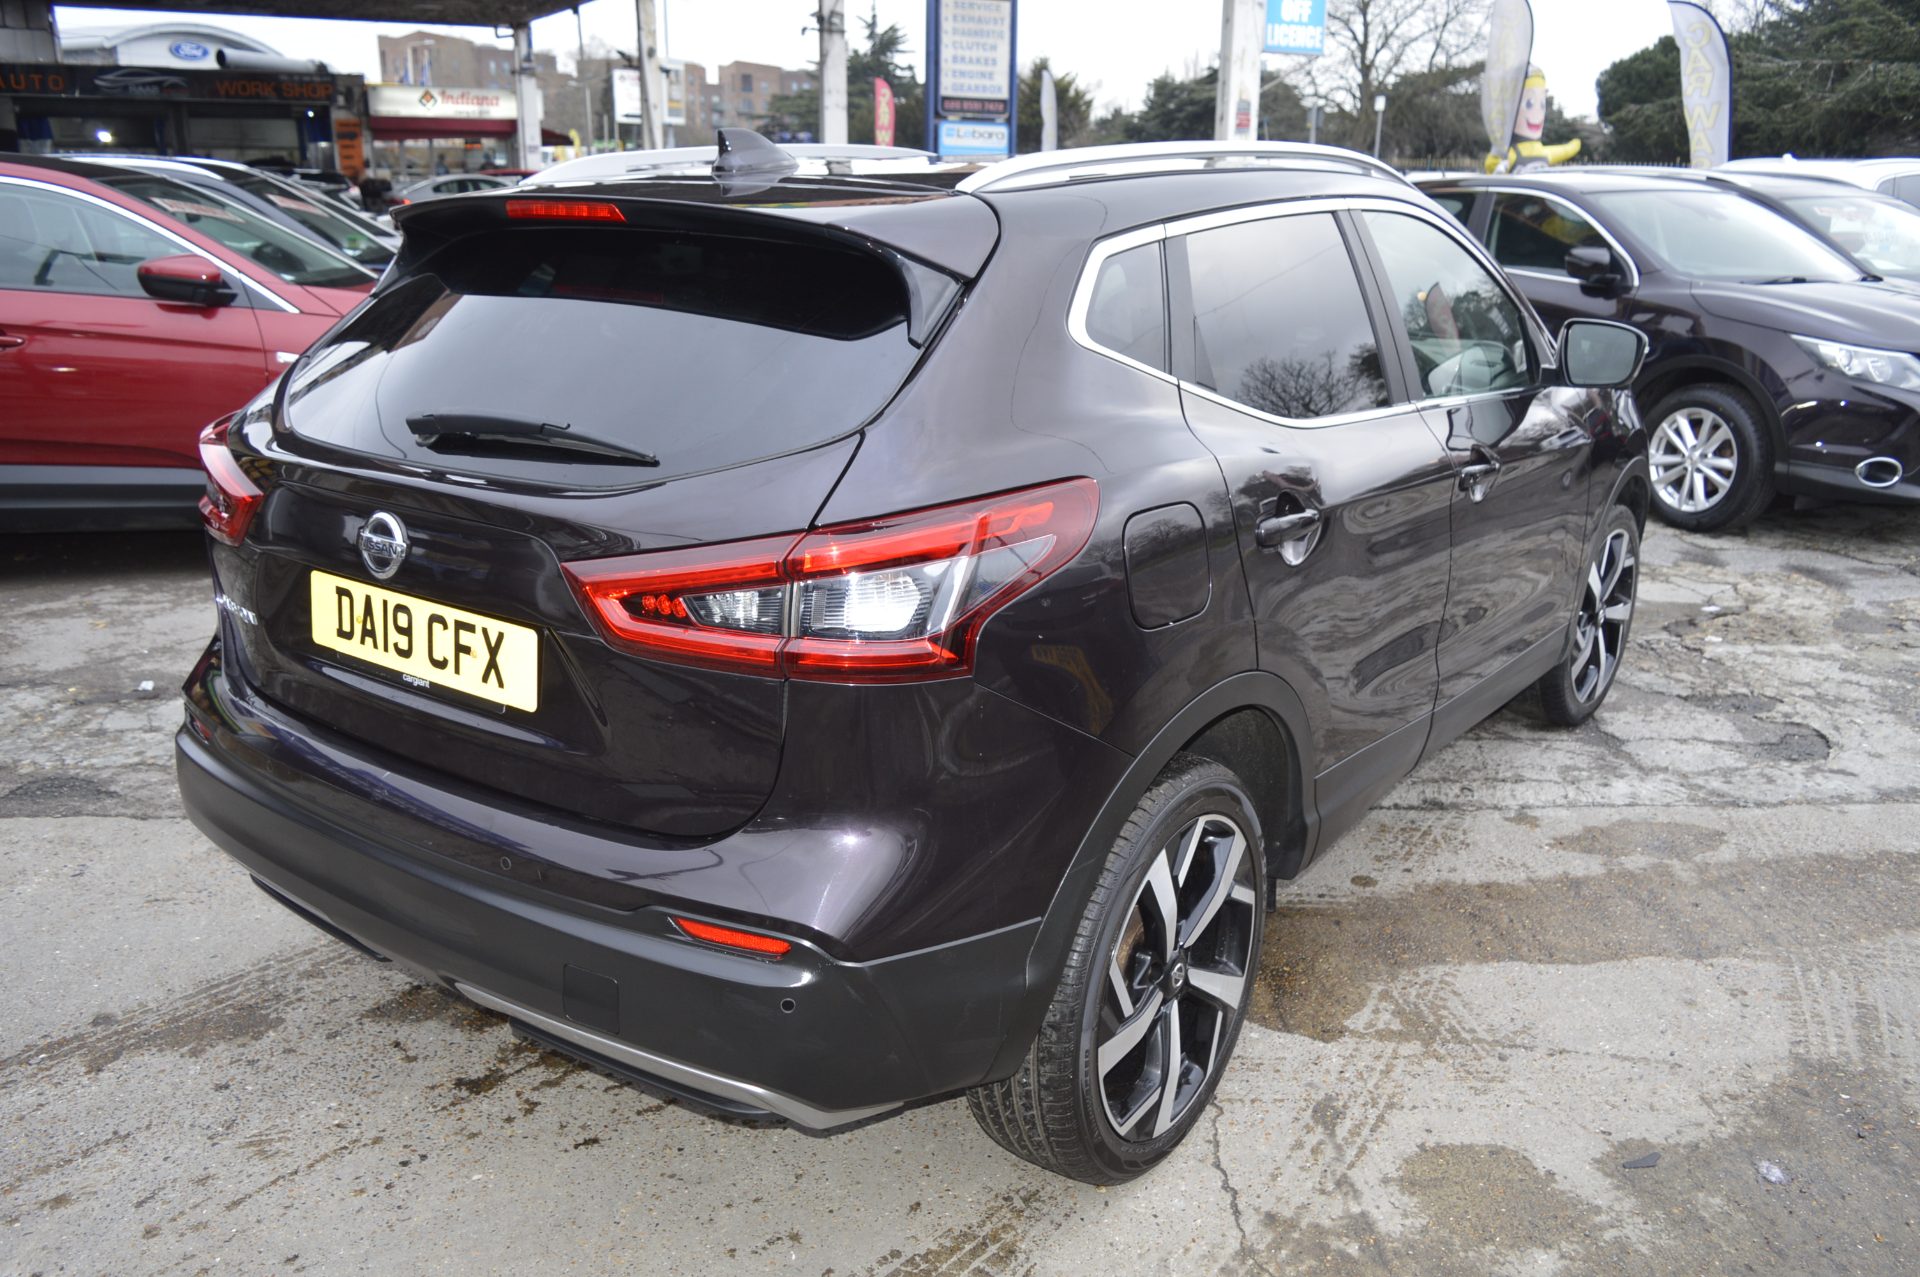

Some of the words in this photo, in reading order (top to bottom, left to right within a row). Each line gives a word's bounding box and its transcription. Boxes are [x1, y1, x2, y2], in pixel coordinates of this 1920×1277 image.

[953, 14, 1005, 26] EXHAUST
[1266, 23, 1323, 48] LICENCE
[952, 41, 998, 52] CLUTCH
[952, 55, 998, 67] BRAKES
[952, 69, 995, 81] ENGINE
[216, 80, 276, 96] WORK
[282, 82, 333, 97] SHOP
[335, 585, 414, 660] DA19
[427, 613, 505, 690] CFX
[402, 673, 430, 689] cargiant
